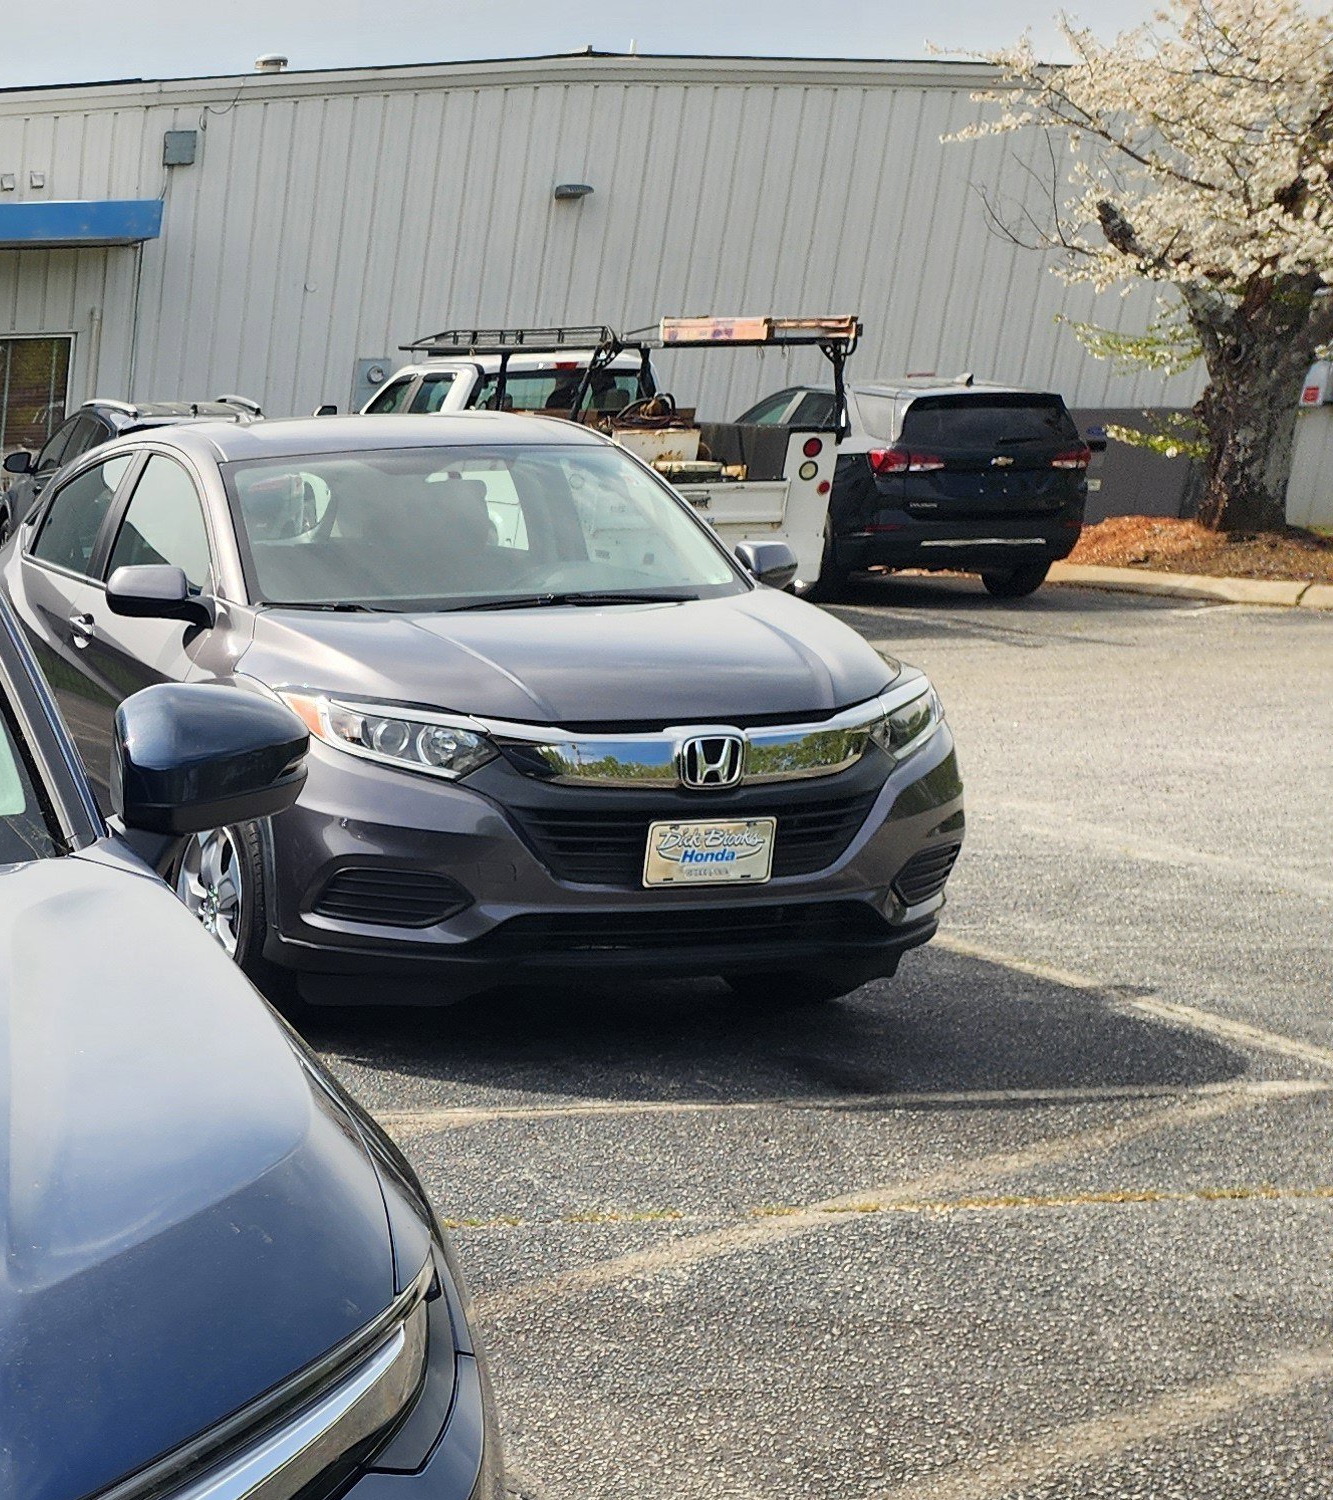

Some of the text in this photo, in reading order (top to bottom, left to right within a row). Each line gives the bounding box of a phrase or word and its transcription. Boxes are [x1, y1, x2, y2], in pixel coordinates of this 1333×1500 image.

[656, 826, 766, 850] Dick Brooks
[681, 849, 736, 863] Honda
